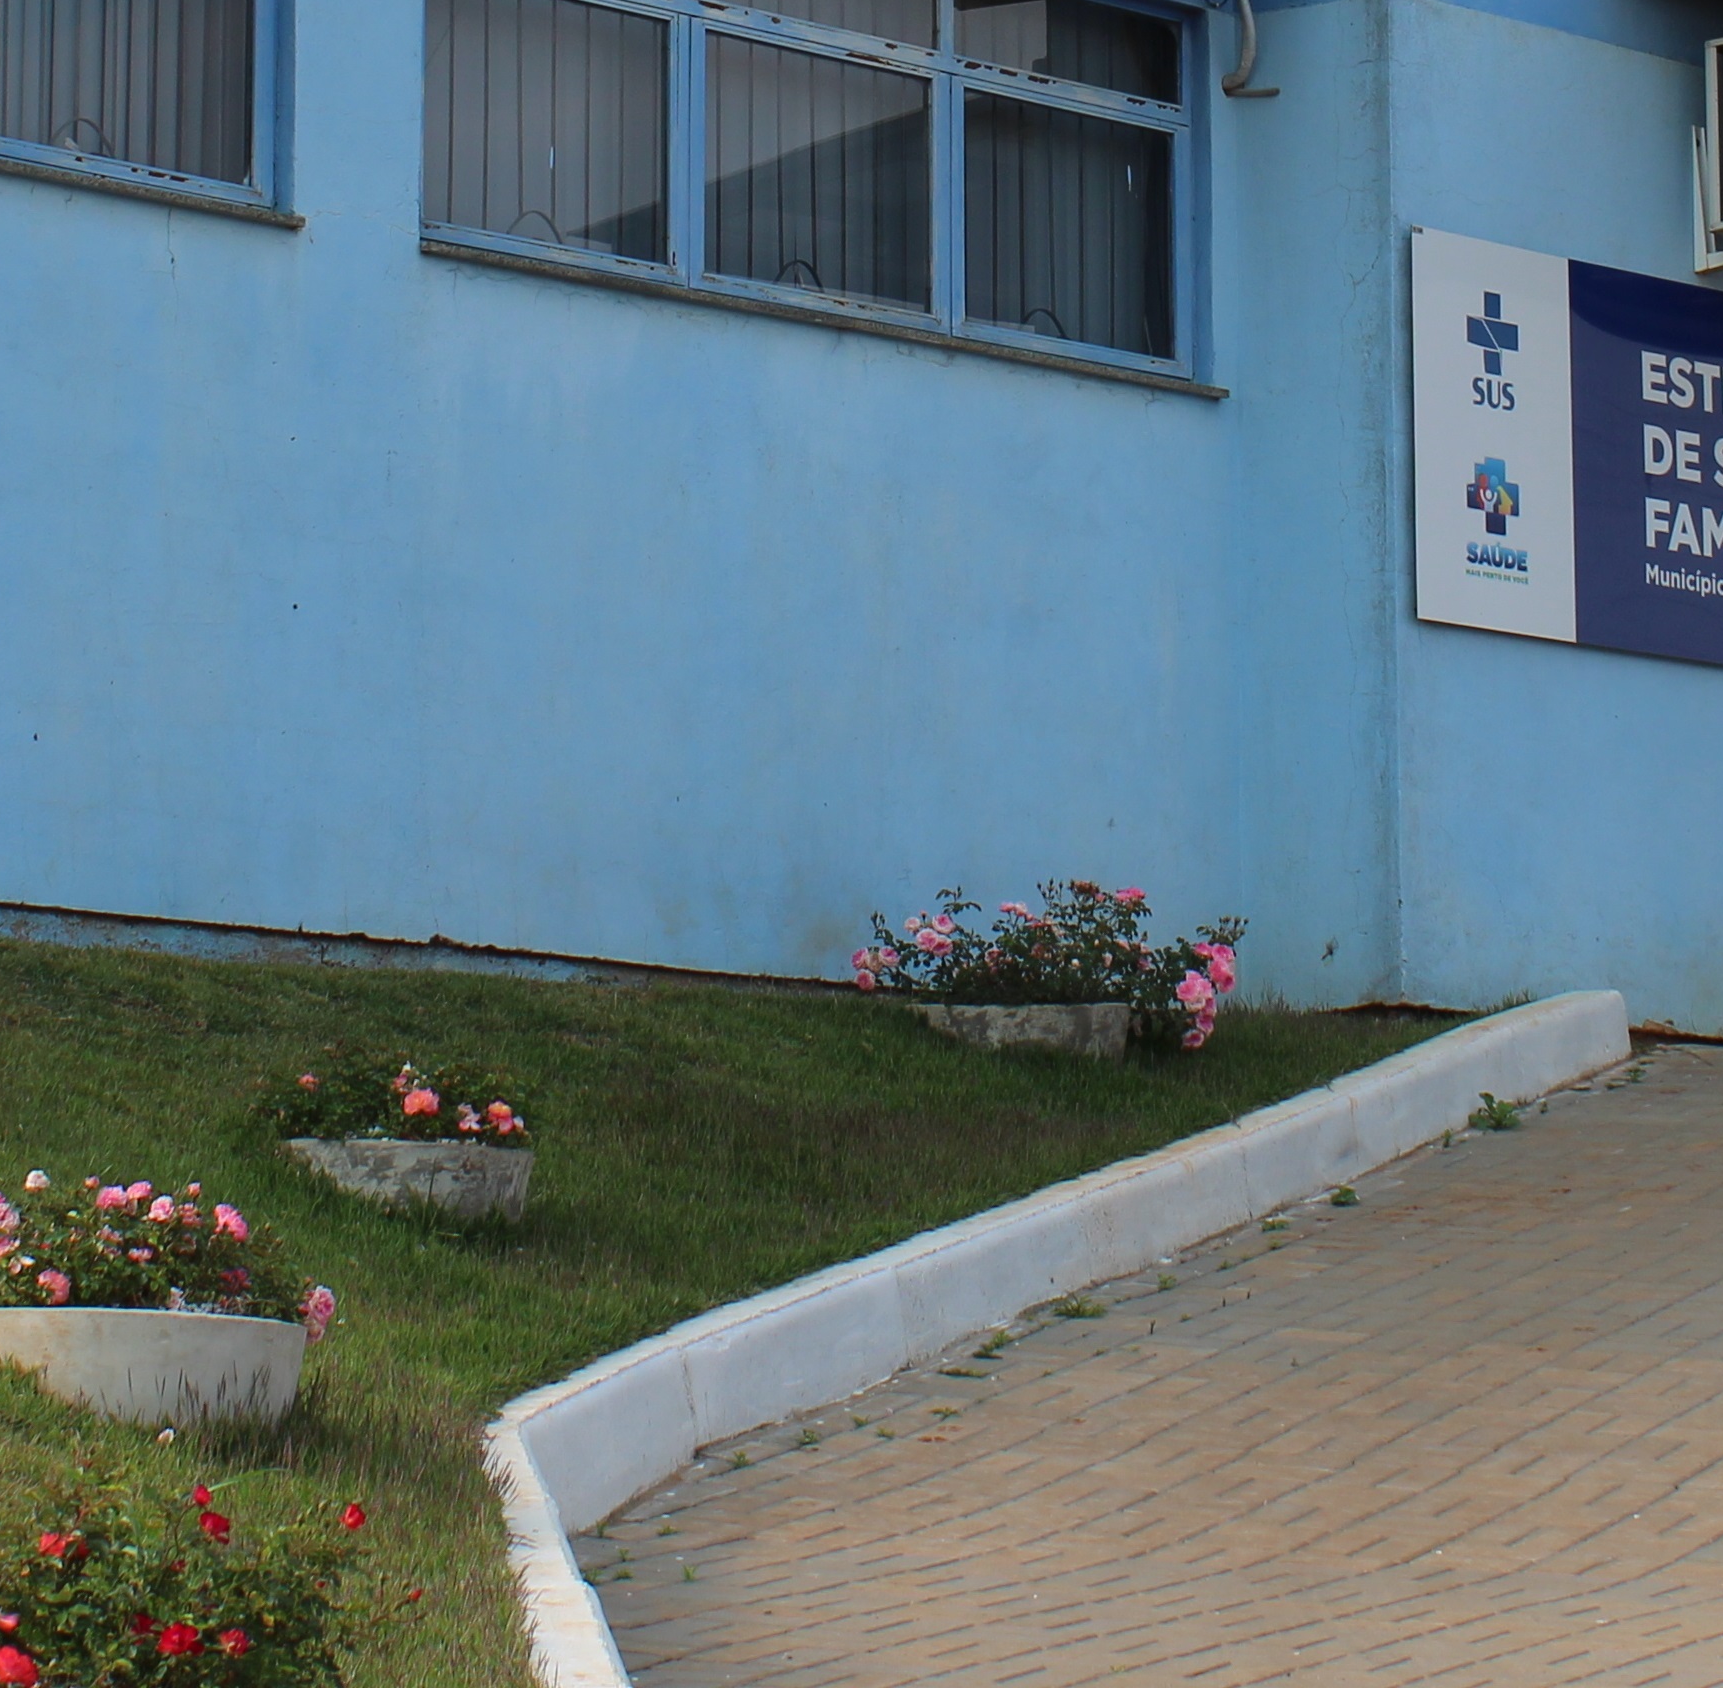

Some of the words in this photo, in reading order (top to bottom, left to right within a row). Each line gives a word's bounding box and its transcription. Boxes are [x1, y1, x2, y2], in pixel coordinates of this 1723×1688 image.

[1472, 376, 1516, 411] SUS
[1643, 423, 1702, 483] DE
[1466, 541, 1528, 572] SAÚDE
